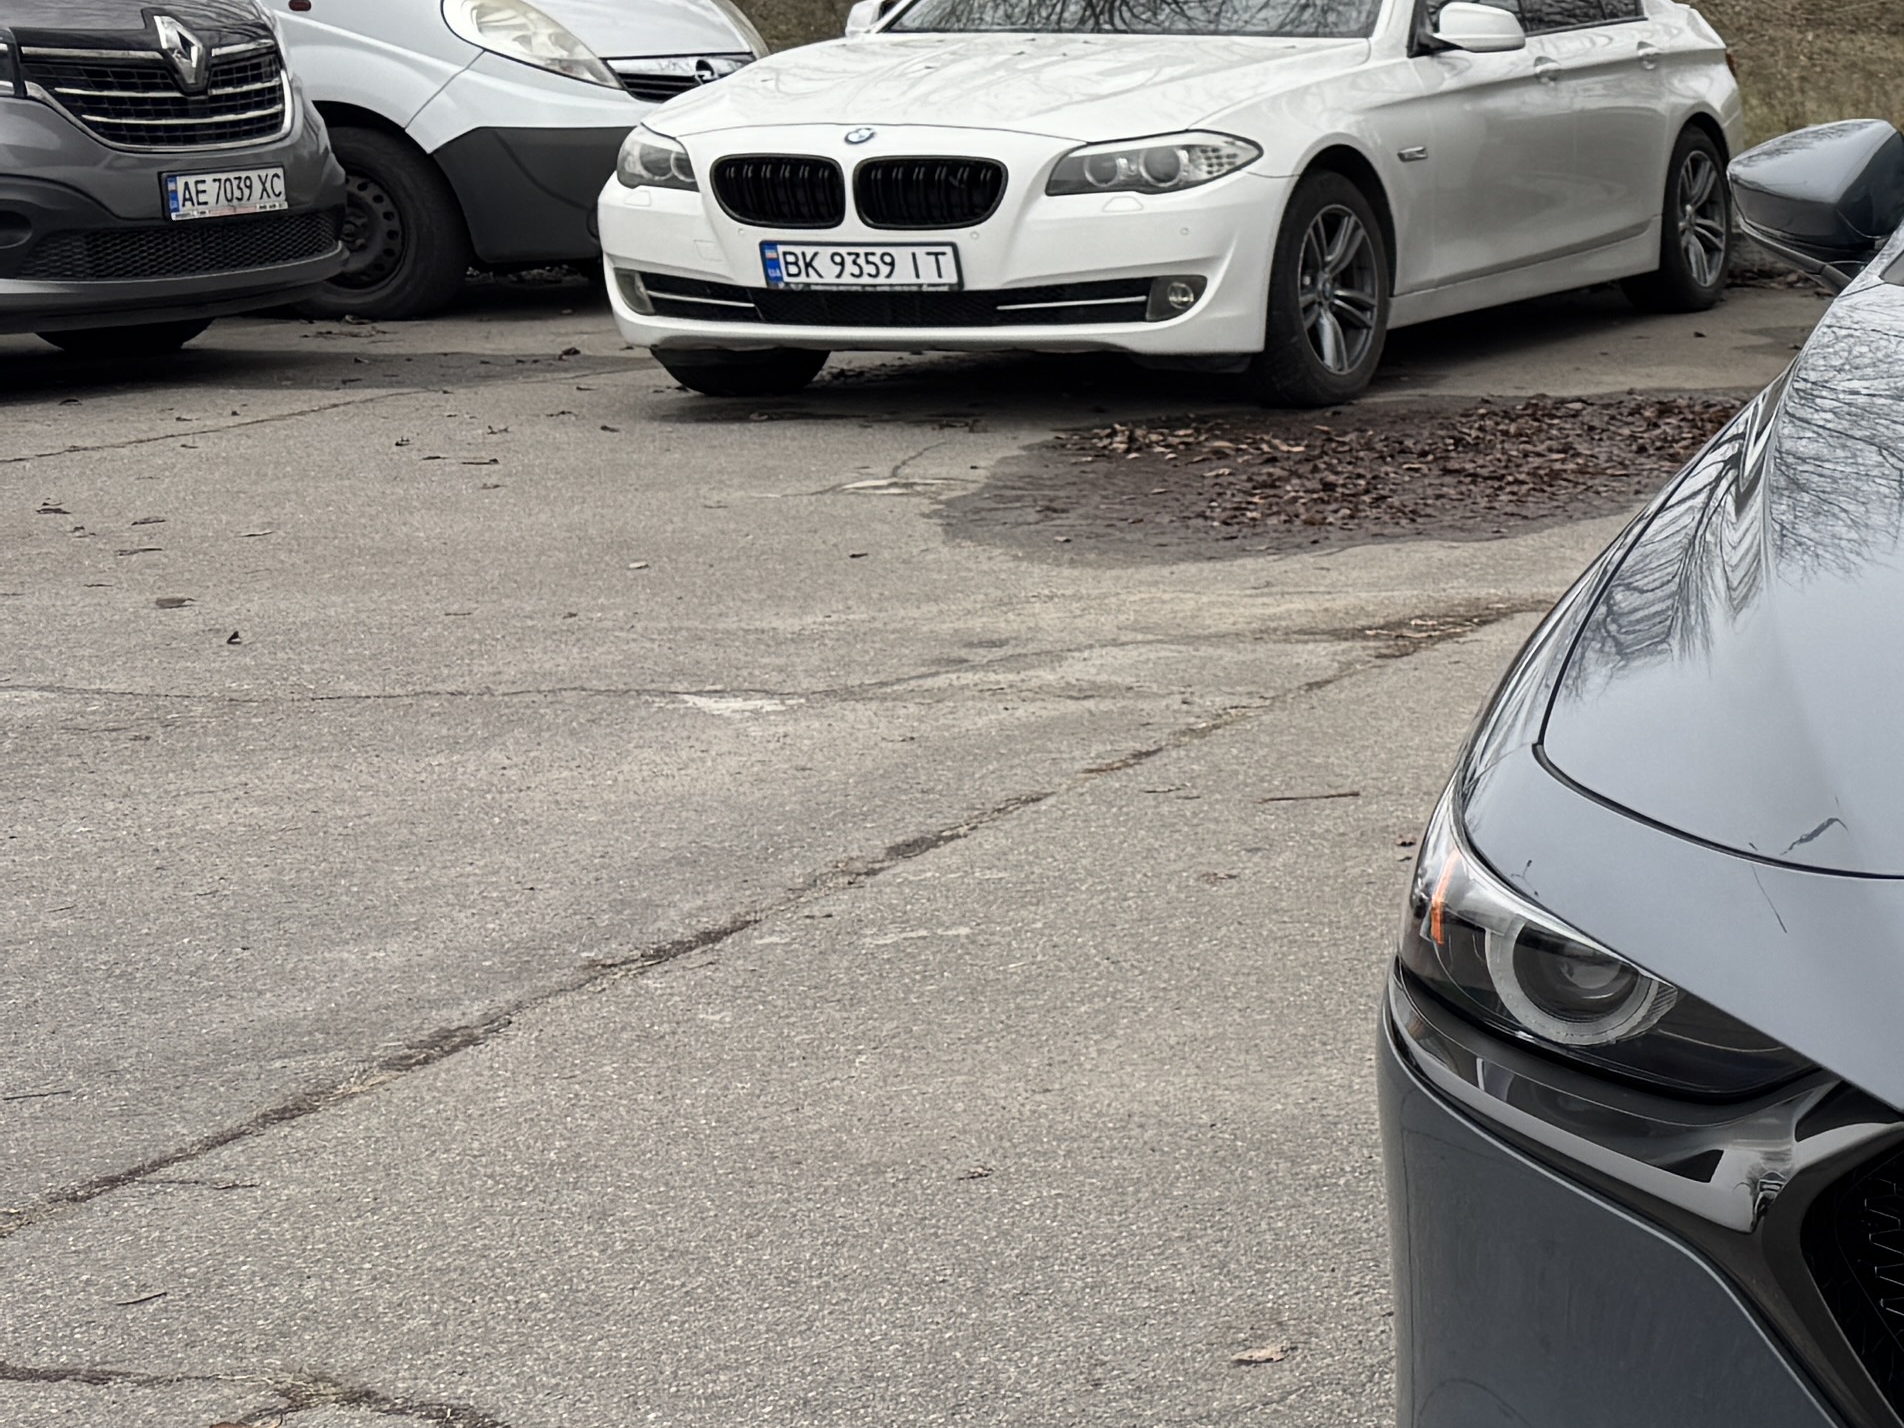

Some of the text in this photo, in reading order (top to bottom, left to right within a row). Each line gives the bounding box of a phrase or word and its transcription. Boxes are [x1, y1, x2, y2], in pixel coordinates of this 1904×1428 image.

[181, 173, 282, 207] AE 7039 XC
[782, 251, 948, 279] BK 9359 IT
